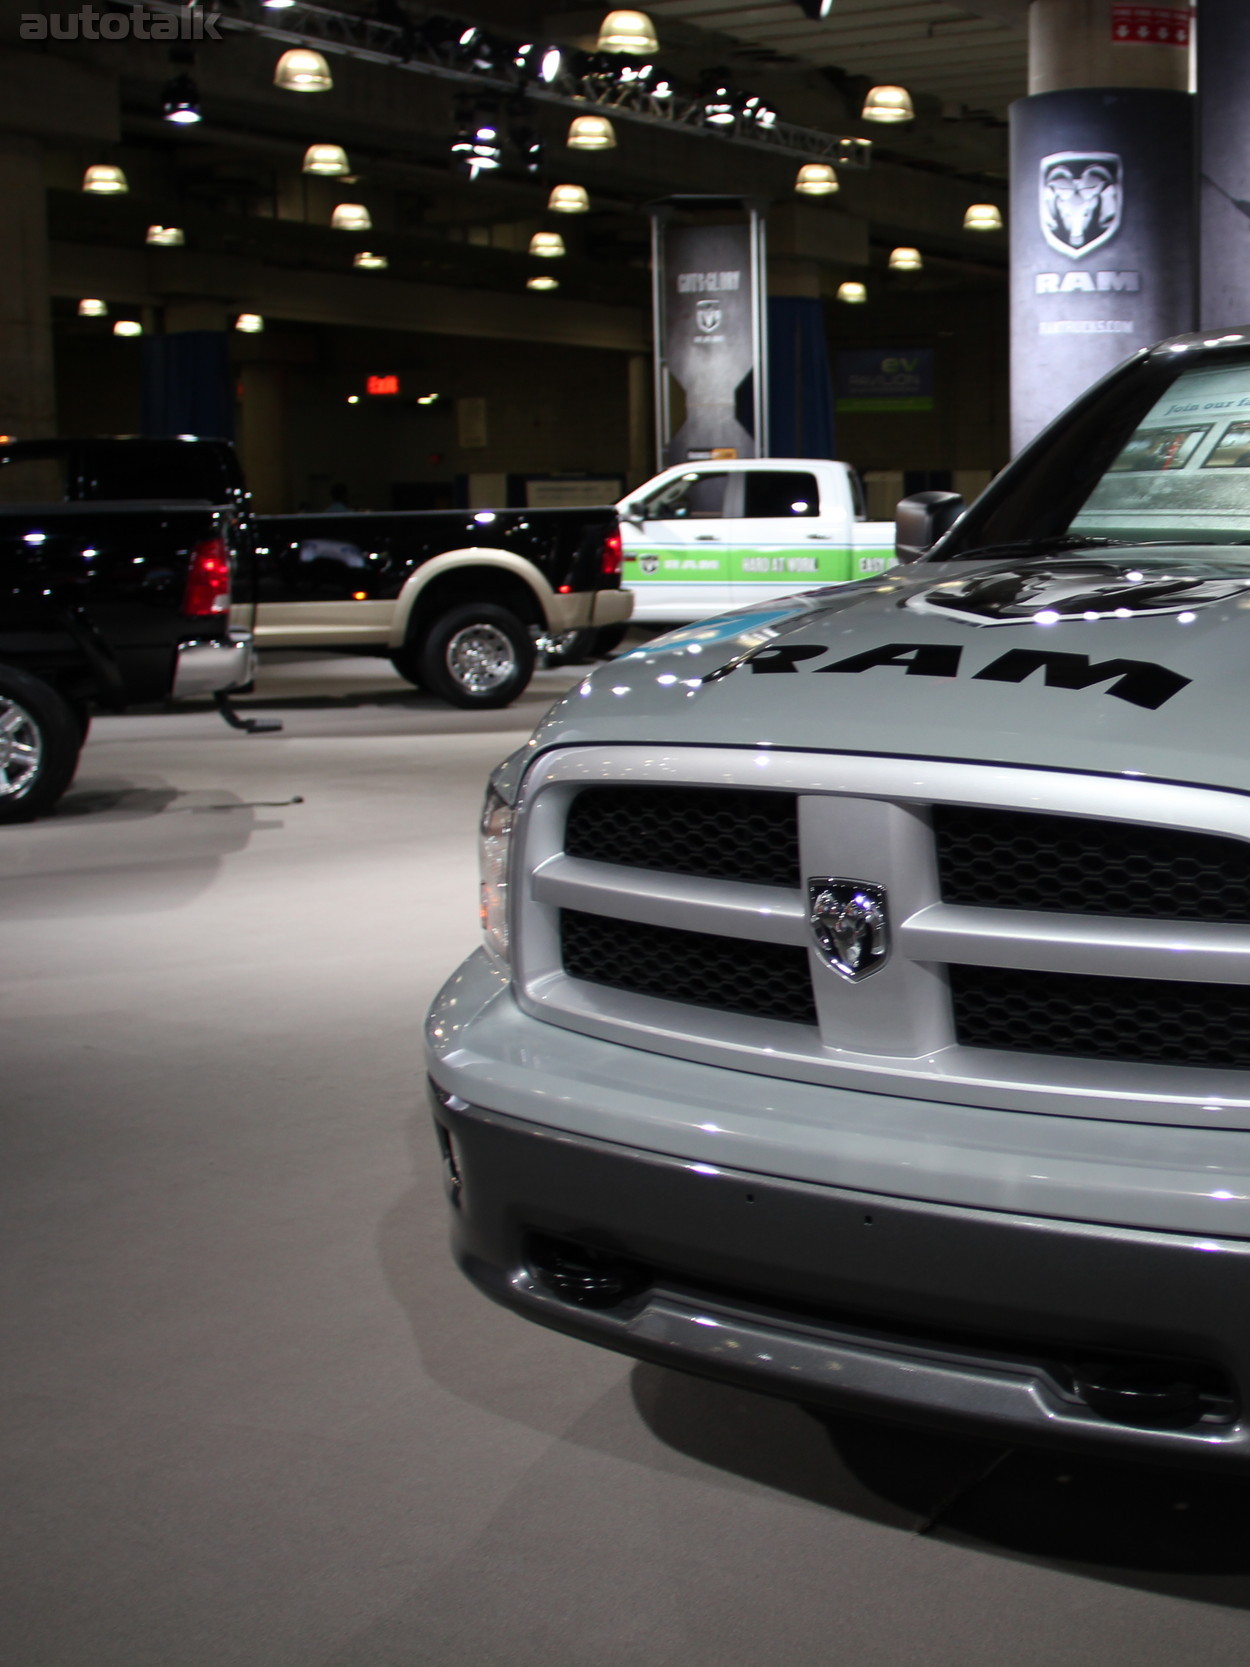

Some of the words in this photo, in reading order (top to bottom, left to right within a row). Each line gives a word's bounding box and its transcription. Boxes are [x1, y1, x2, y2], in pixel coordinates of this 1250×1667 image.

[1035, 270, 1140, 294] RAM
[1165, 403, 1199, 415] Join
[1203, 401, 1233, 410] our
[701, 643, 1193, 710] RAM
